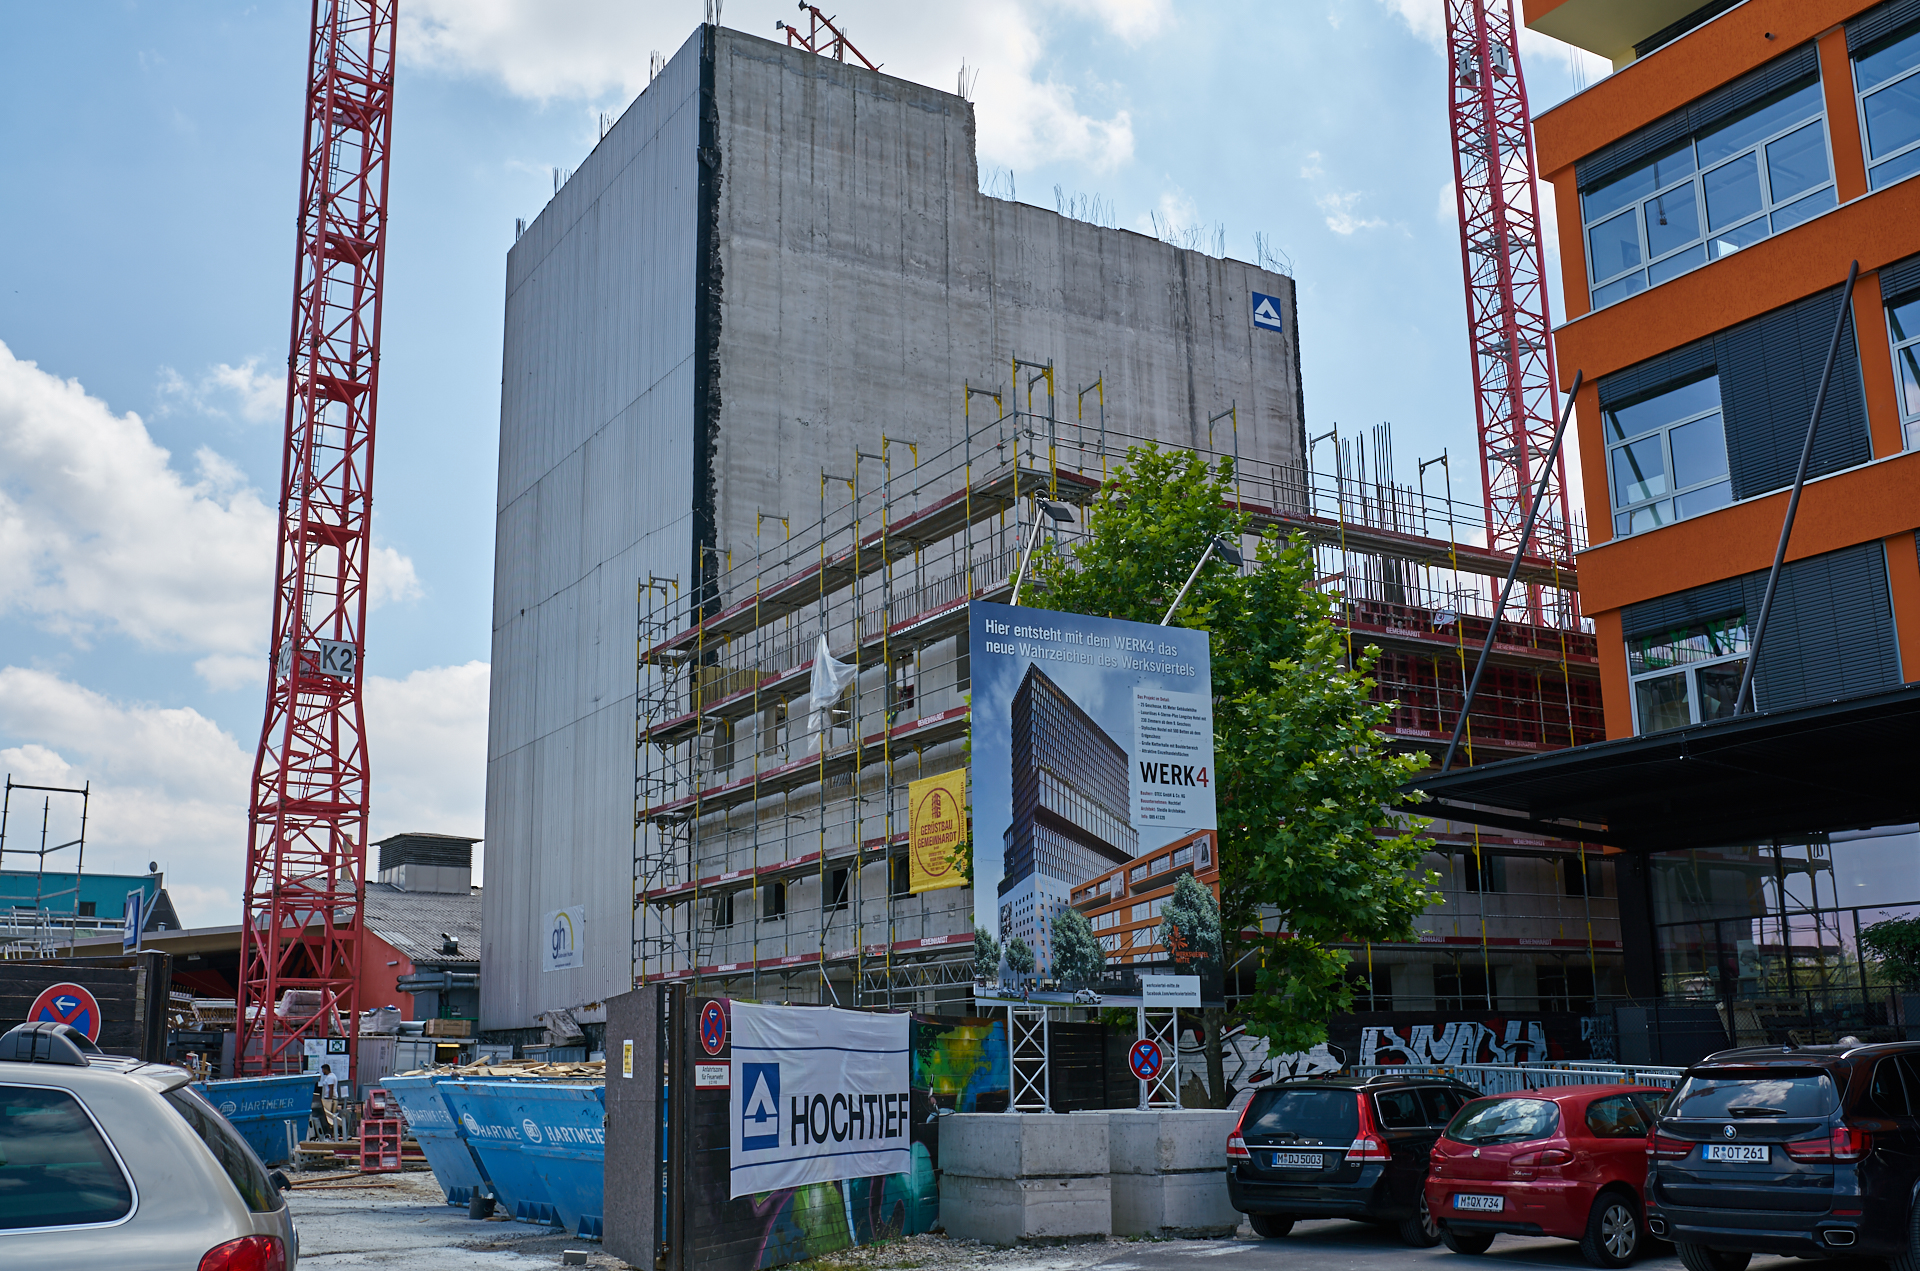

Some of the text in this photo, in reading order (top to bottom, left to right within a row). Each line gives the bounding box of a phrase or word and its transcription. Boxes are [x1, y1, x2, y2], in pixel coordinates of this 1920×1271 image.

[986, 619, 1178, 656] Hier entsteht mit dem WERK4 das
[1385, 627, 1420, 638] GEMEINHARDT
[323, 645, 352, 672] K2
[986, 641, 1195, 676] neue Wahrzeichen des Werksviertels
[1140, 761, 1209, 788] WERK4
[921, 819, 952, 836] GERÜSTBAU
[918, 831, 957, 848] GEMEINHARDT
[552, 921, 565, 959] gh
[241, 1098, 294, 1112] HARTMEIER
[791, 1092, 909, 1146] HOCHTIEF
[544, 1126, 605, 1144] HARTMEIE
[1713, 1147, 1719, 1158] R
[1744, 1148, 1764, 1159] 261
[1461, 1196, 1498, 1208] M QX 734
